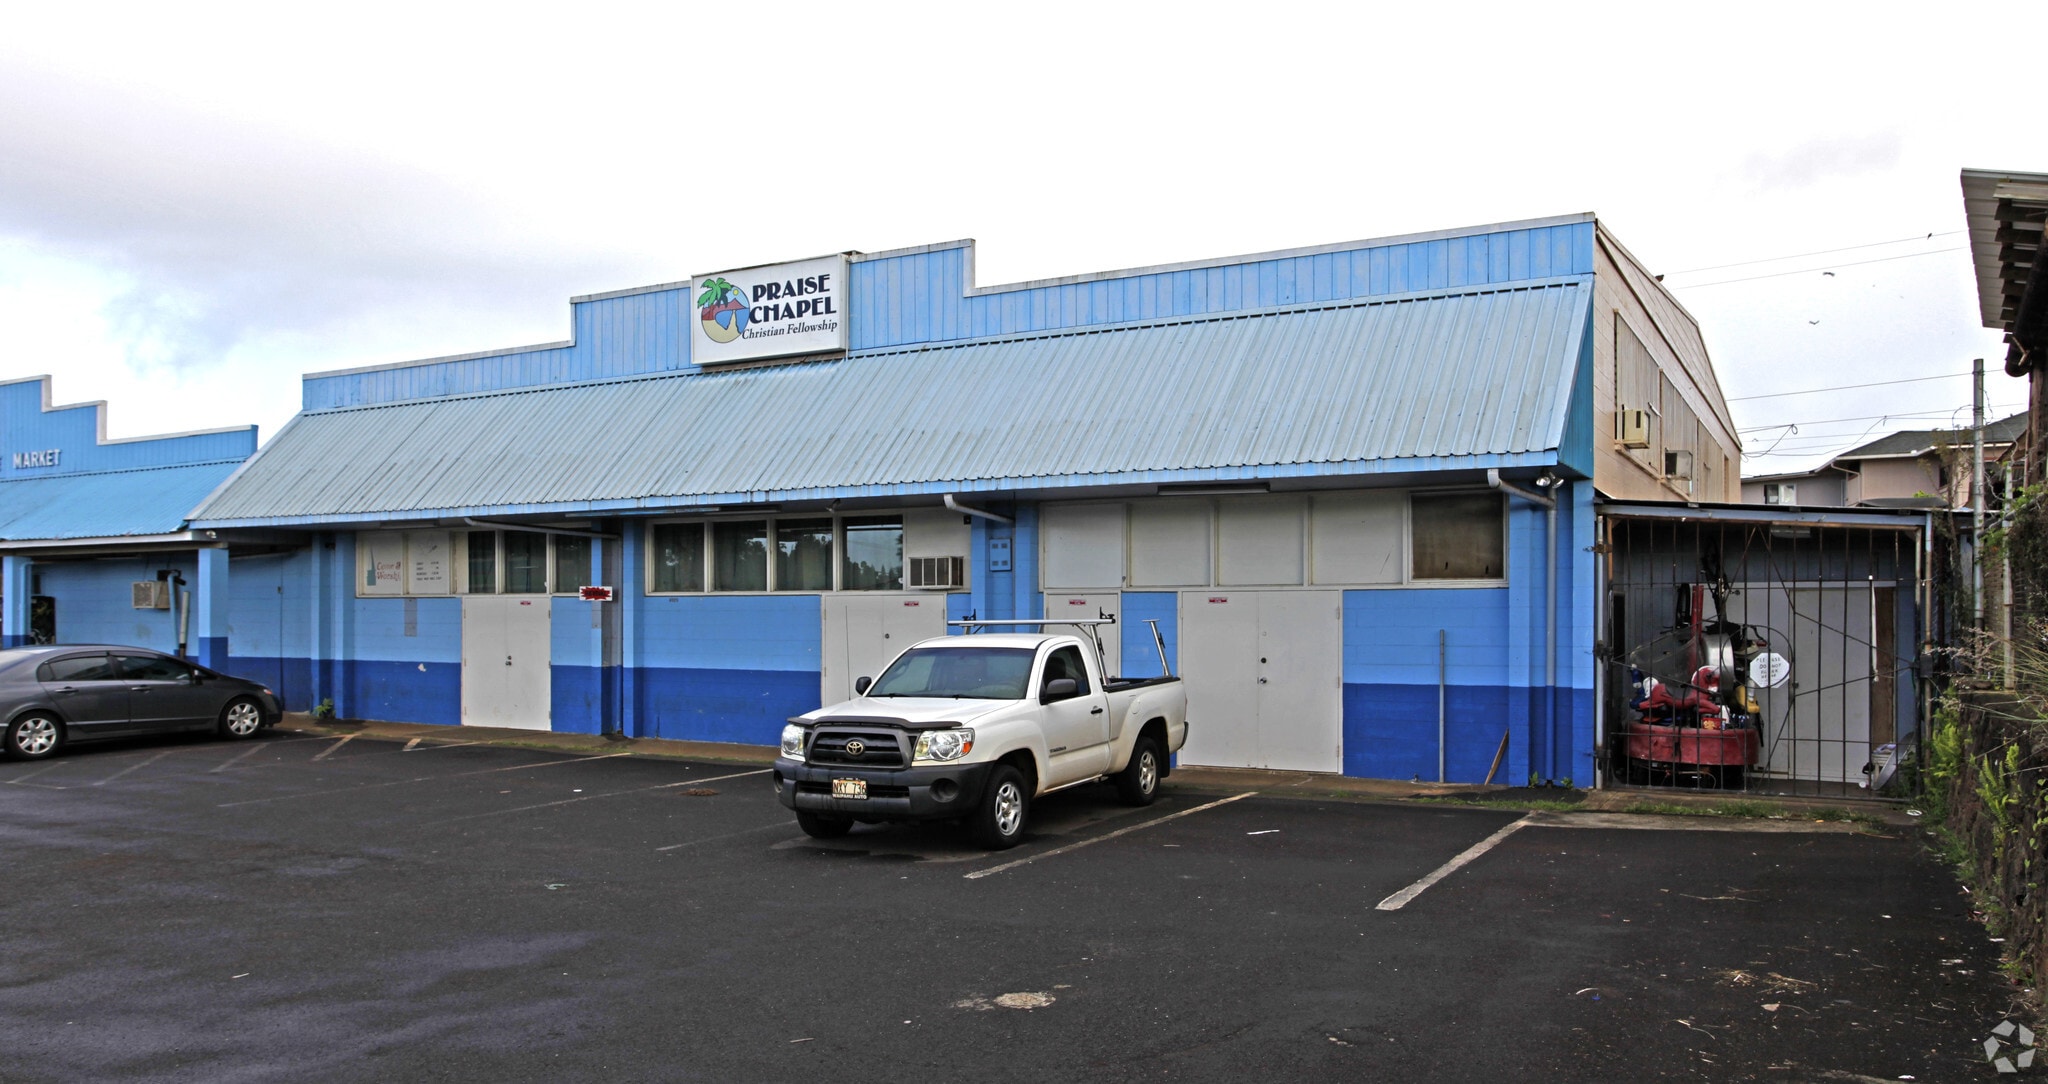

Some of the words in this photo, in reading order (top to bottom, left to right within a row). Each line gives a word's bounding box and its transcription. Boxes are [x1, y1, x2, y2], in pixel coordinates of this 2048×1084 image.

[752, 274, 830, 303] PRAISE
[749, 296, 837, 324] CHAPEL
[742, 327, 785, 340] Christian
[787, 319, 838, 335] Fellowship
[12, 449, 61, 469] MARKET
